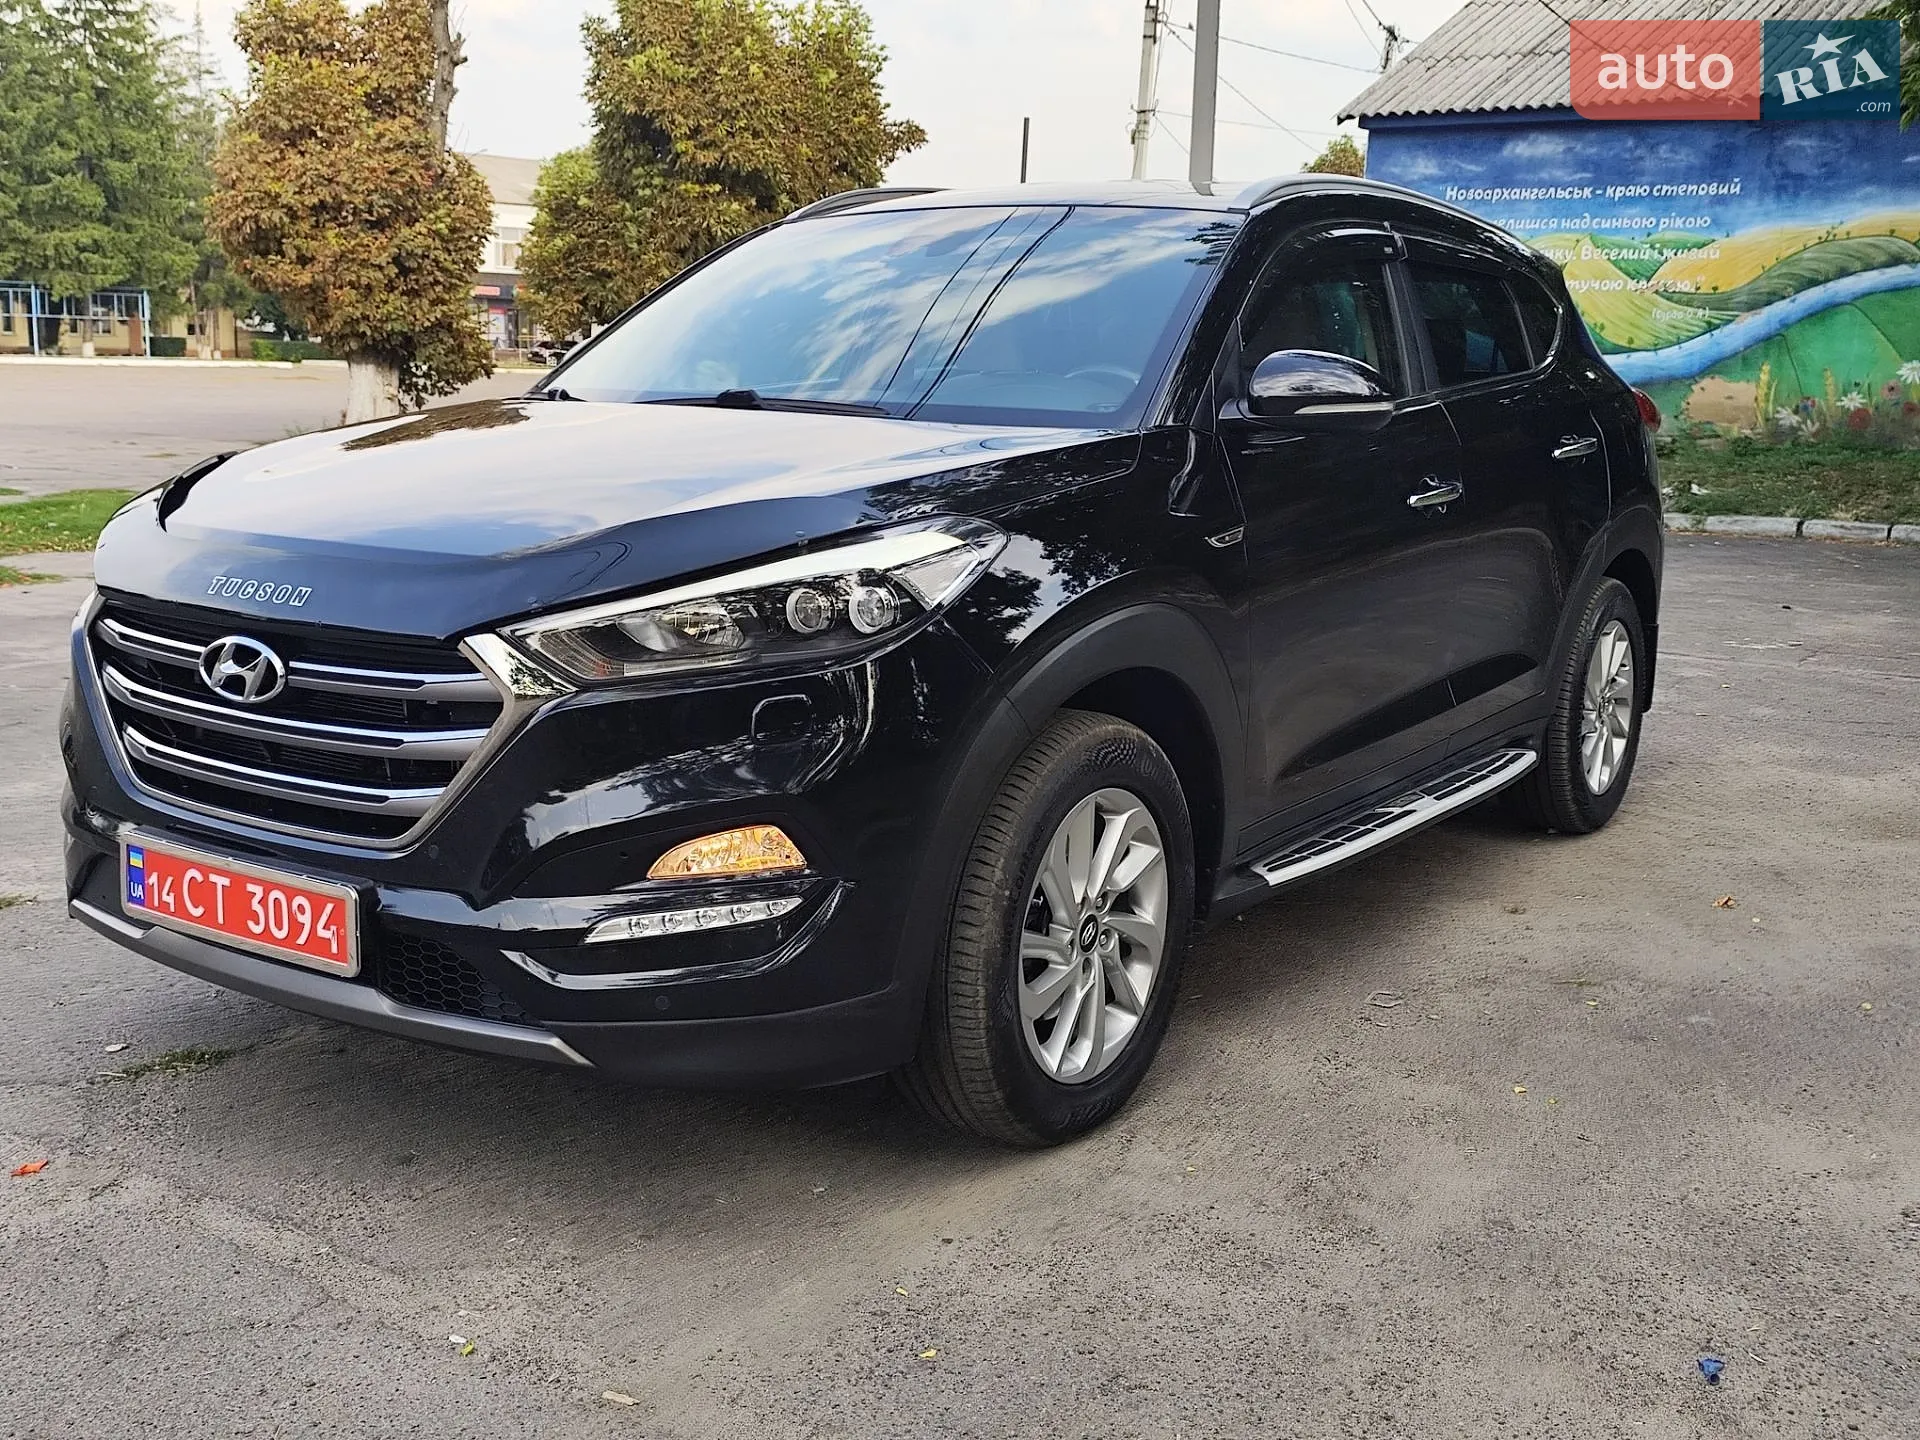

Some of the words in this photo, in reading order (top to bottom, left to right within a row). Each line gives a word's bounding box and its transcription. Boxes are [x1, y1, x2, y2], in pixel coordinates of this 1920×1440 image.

[1605, 184, 1649, 201] краю
[1653, 178, 1741, 197] степовий
[1494, 217, 1558, 230] елишся
[1561, 213, 1591, 230] над
[1592, 217, 1656, 229] синьою
[1659, 212, 1711, 231] рікою
[1581, 243, 1650, 261] Веселий
[1565, 279, 1624, 293] тучою
[207, 576, 312, 607] TUCSON
[130, 881, 145, 900] UA
[148, 871, 176, 913] 14
[182, 867, 232, 925] CT
[246, 882, 339, 954] 3094
